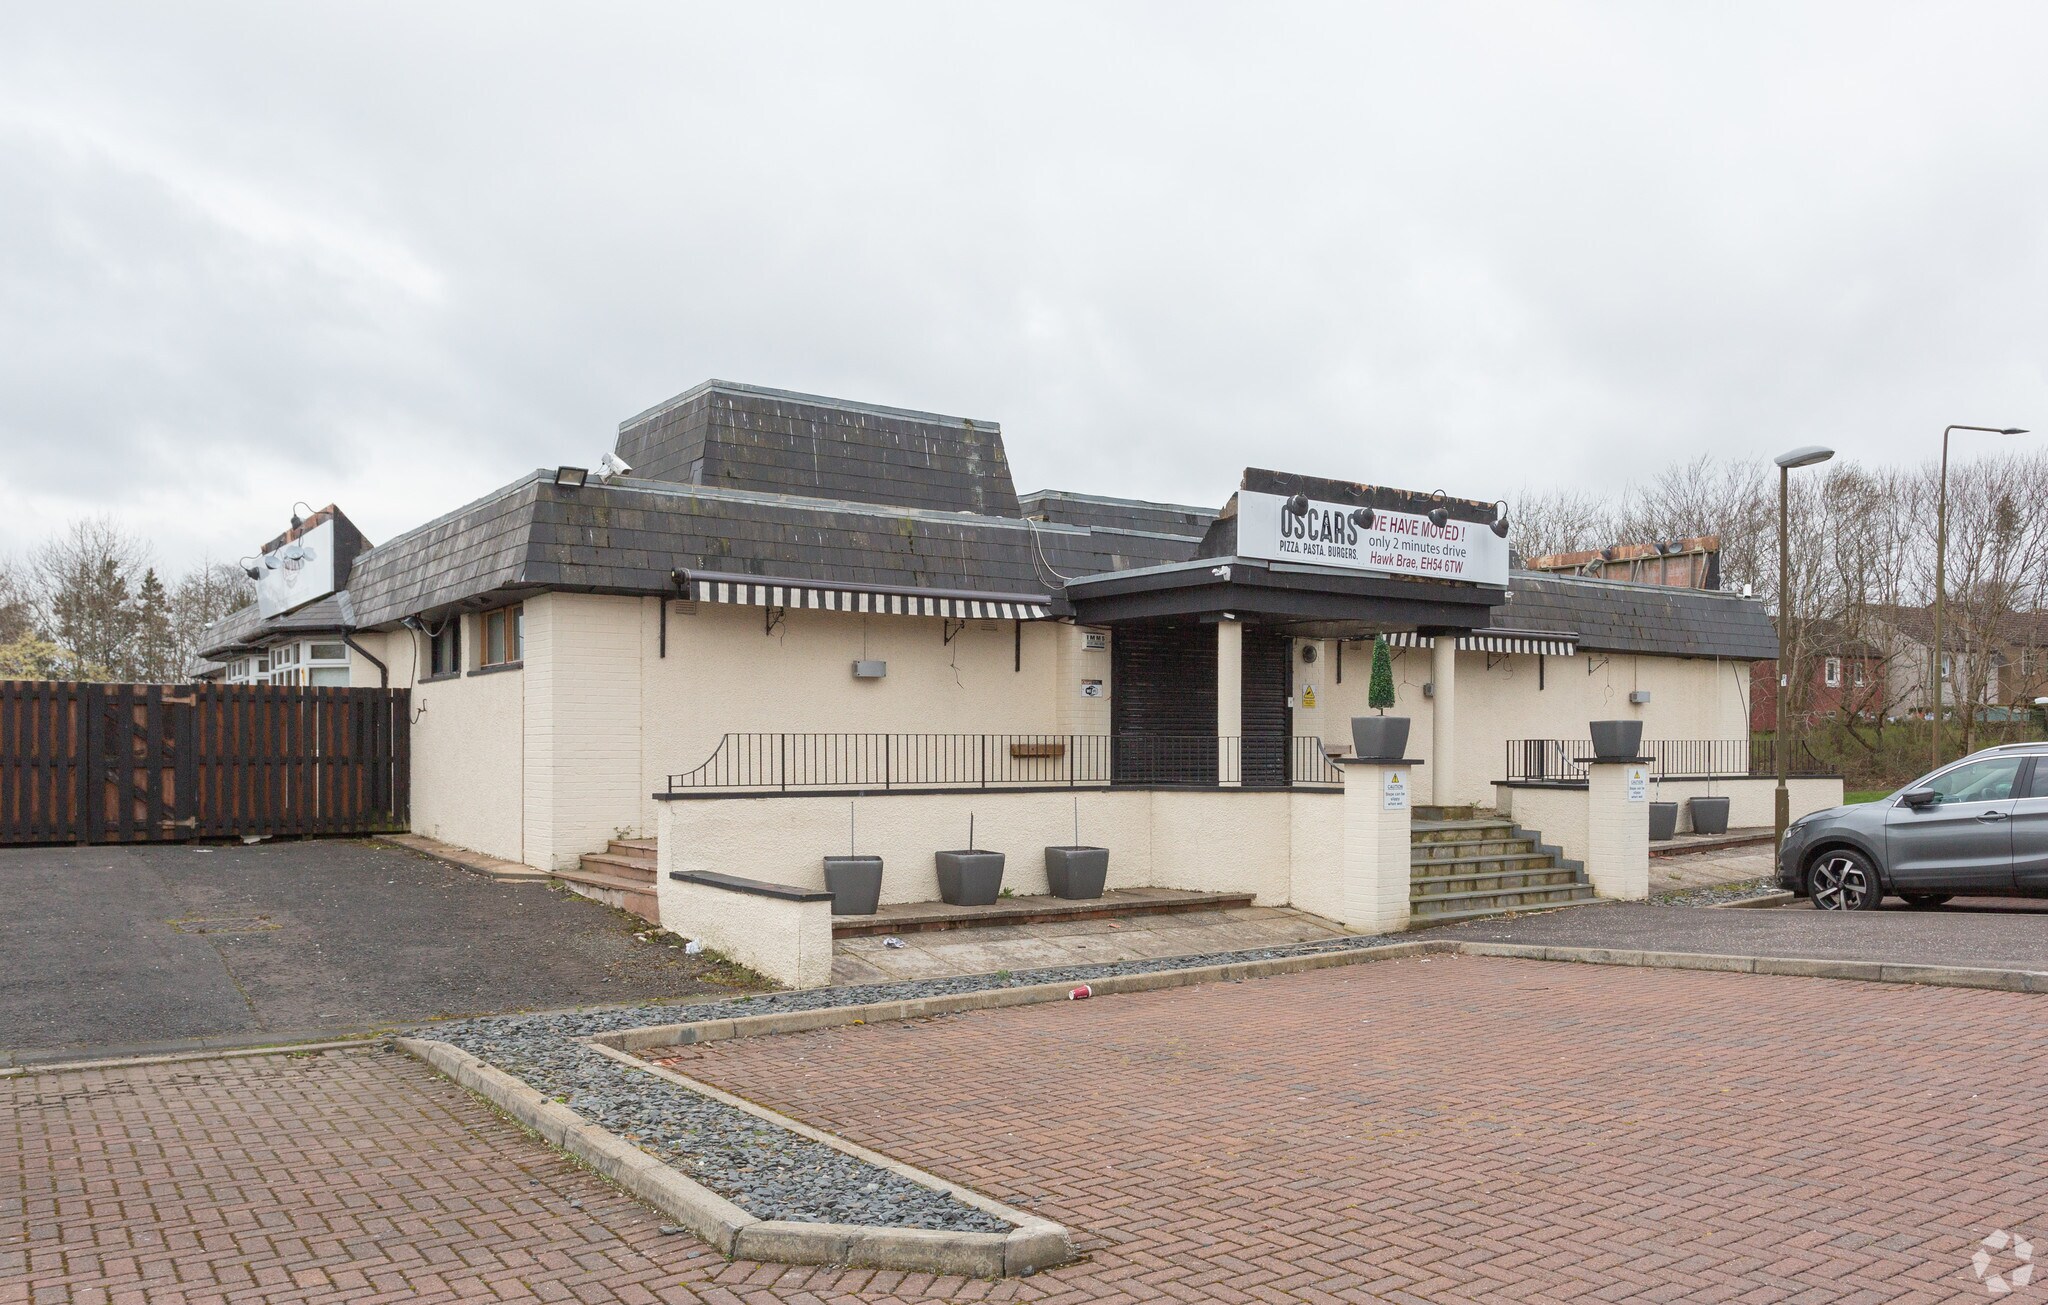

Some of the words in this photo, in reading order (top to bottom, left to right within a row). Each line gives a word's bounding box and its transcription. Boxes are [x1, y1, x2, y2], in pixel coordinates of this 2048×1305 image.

[1281, 505, 1358, 546] OSCARS
[1389, 516, 1419, 536] HAVE
[1421, 520, 1459, 541] MOVED
[1279, 539, 1302, 554] PIZZA.
[1303, 542, 1326, 556] PASTA.
[1327, 545, 1359, 560] BURGERS.
[1368, 535, 1391, 551] only
[1393, 537, 1399, 550] 2
[1401, 540, 1441, 555] minutes
[1442, 544, 1467, 558] drive
[1369, 551, 1394, 566] Hawk
[1396, 554, 1418, 571] Brae,
[1420, 556, 1442, 572] EH54
[1444, 560, 1464, 574] 6TW
